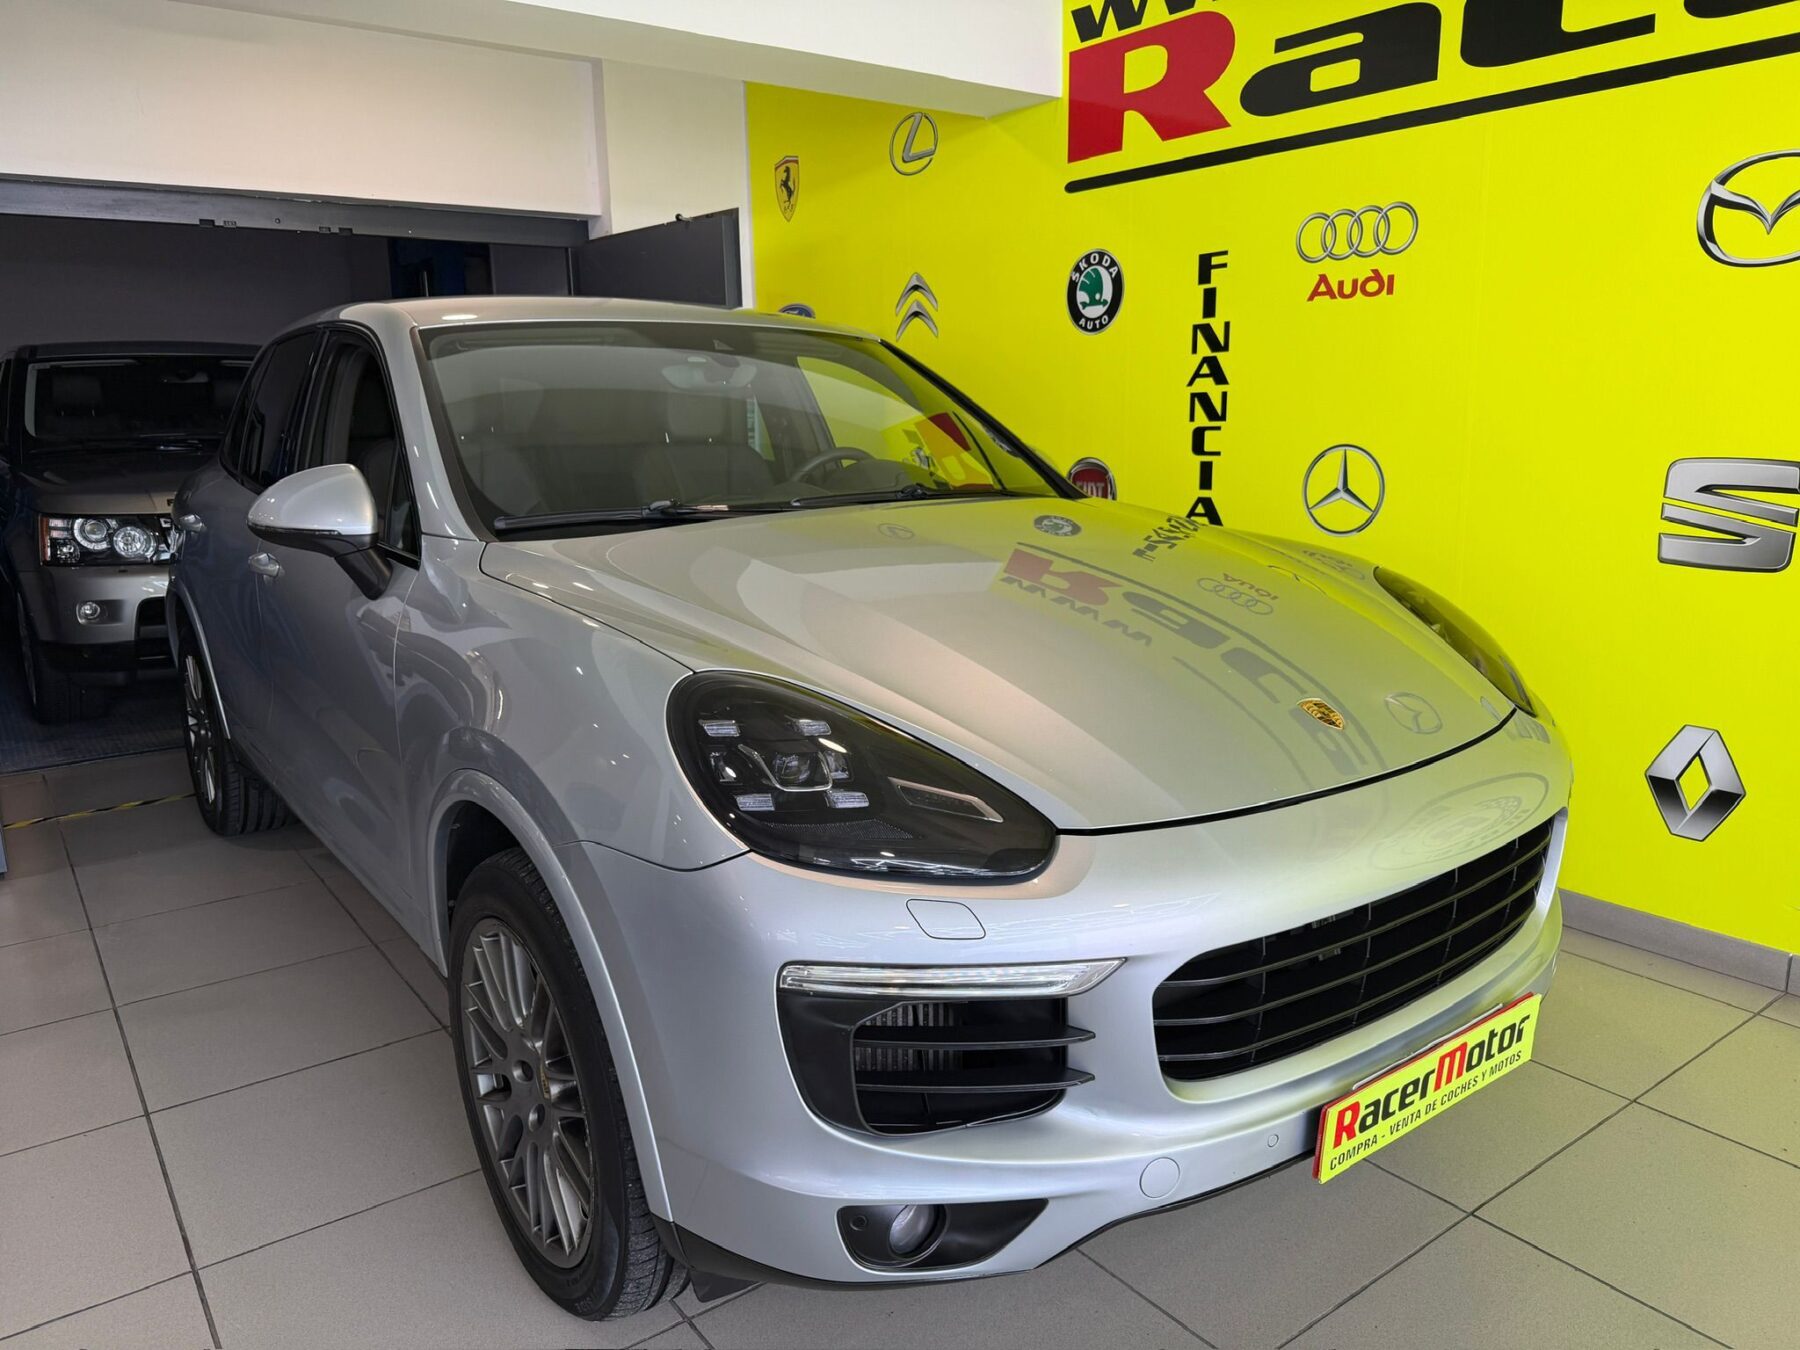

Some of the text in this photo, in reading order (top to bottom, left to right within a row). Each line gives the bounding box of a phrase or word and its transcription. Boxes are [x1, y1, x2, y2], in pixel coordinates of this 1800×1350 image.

[1078, 315, 1109, 330] AUTO
[1306, 268, 1395, 302] Audi
[1329, 1134, 1379, 1171] COMPRA
[1389, 1108, 1421, 1136] VENTA
[1425, 1098, 1438, 1116] DE
[1440, 1075, 1479, 1107] COCHES
[1481, 1070, 1488, 1082] Y
[1488, 1050, 1522, 1078] MOTOS
[1333, 1014, 1531, 1149] RacerMotor
